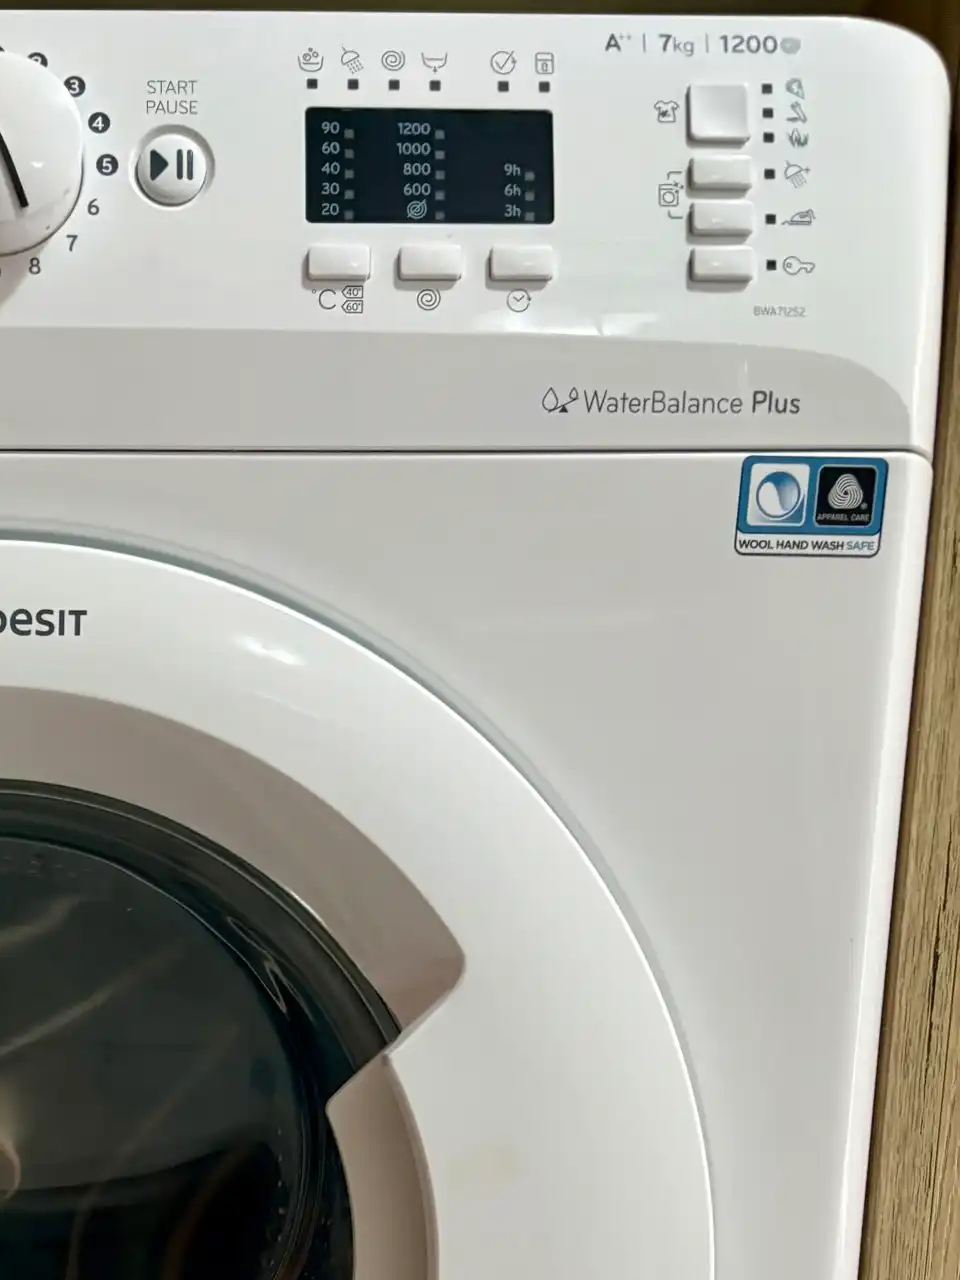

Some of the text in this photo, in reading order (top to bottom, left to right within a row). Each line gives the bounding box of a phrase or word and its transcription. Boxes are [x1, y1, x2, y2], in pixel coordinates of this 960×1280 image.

[659, 34, 695, 57] 7kg
[719, 35, 779, 54] 1200
[147, 80, 197, 95] START
[146, 100, 198, 115] PAUSE
[90, 114, 106, 132] 4
[321, 121, 340, 134] 90
[398, 122, 431, 135] 1200
[322, 141, 340, 154] 60
[396, 142, 431, 156] 1000
[100, 156, 114, 174] 5
[321, 161, 340, 174] 40
[403, 163, 431, 176] 800
[504, 163, 521, 176] 9h
[321, 182, 340, 195] 30
[403, 183, 431, 196] 600
[504, 184, 521, 196] 6h
[87, 198, 100, 216] 6
[321, 203, 339, 216] 20
[504, 204, 521, 217] 3h
[66, 234, 78, 252] 7
[27, 258, 41, 275] 8
[584, 389, 800, 414] WaterBalance Plus
[817, 513, 870, 522] APPAREL CARE
[738, 539, 874, 551] WOOL HAND WASH SAFE
